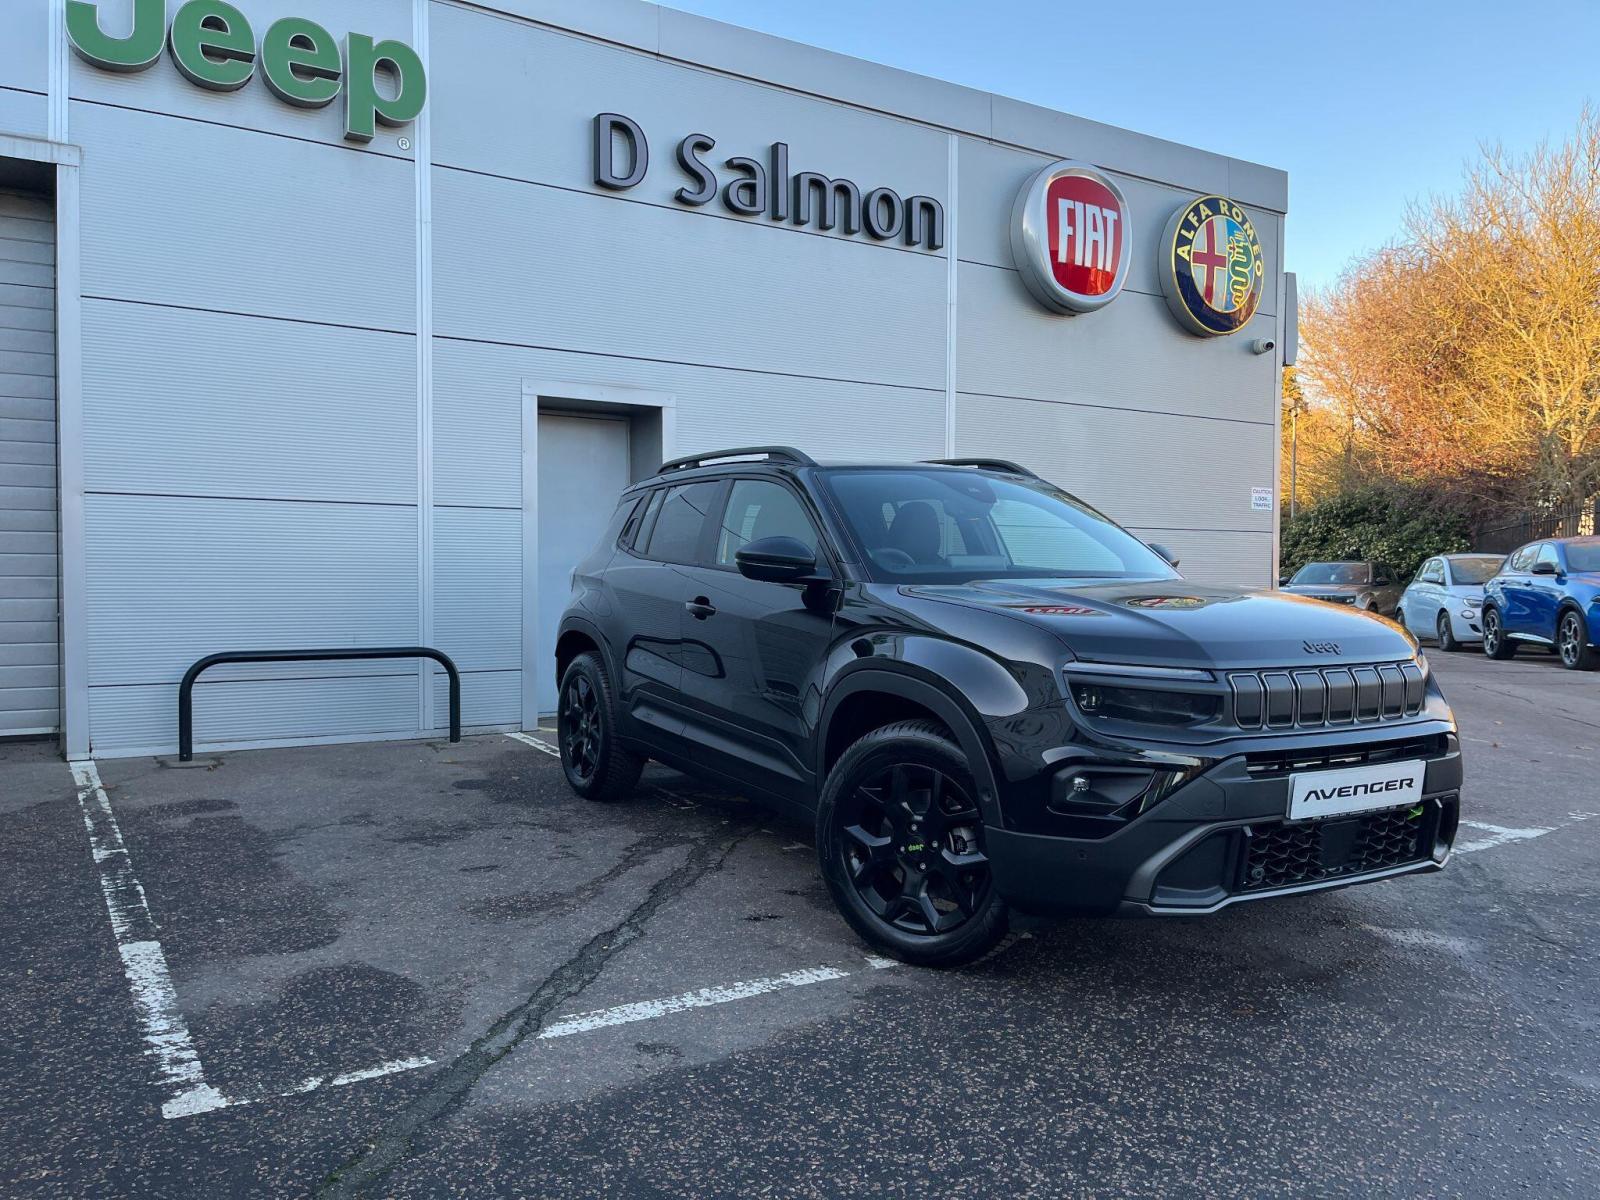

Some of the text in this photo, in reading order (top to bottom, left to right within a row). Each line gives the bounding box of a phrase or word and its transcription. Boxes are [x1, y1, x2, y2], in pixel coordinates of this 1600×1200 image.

[65, 0, 427, 143] Jeep
[592, 112, 945, 251] D Salmon
[1058, 198, 1118, 273] FIAT
[1177, 200, 1262, 277] ALFA ROMEO
[1302, 640, 1342, 656] Jeep
[1303, 778, 1415, 802] AVENGER
